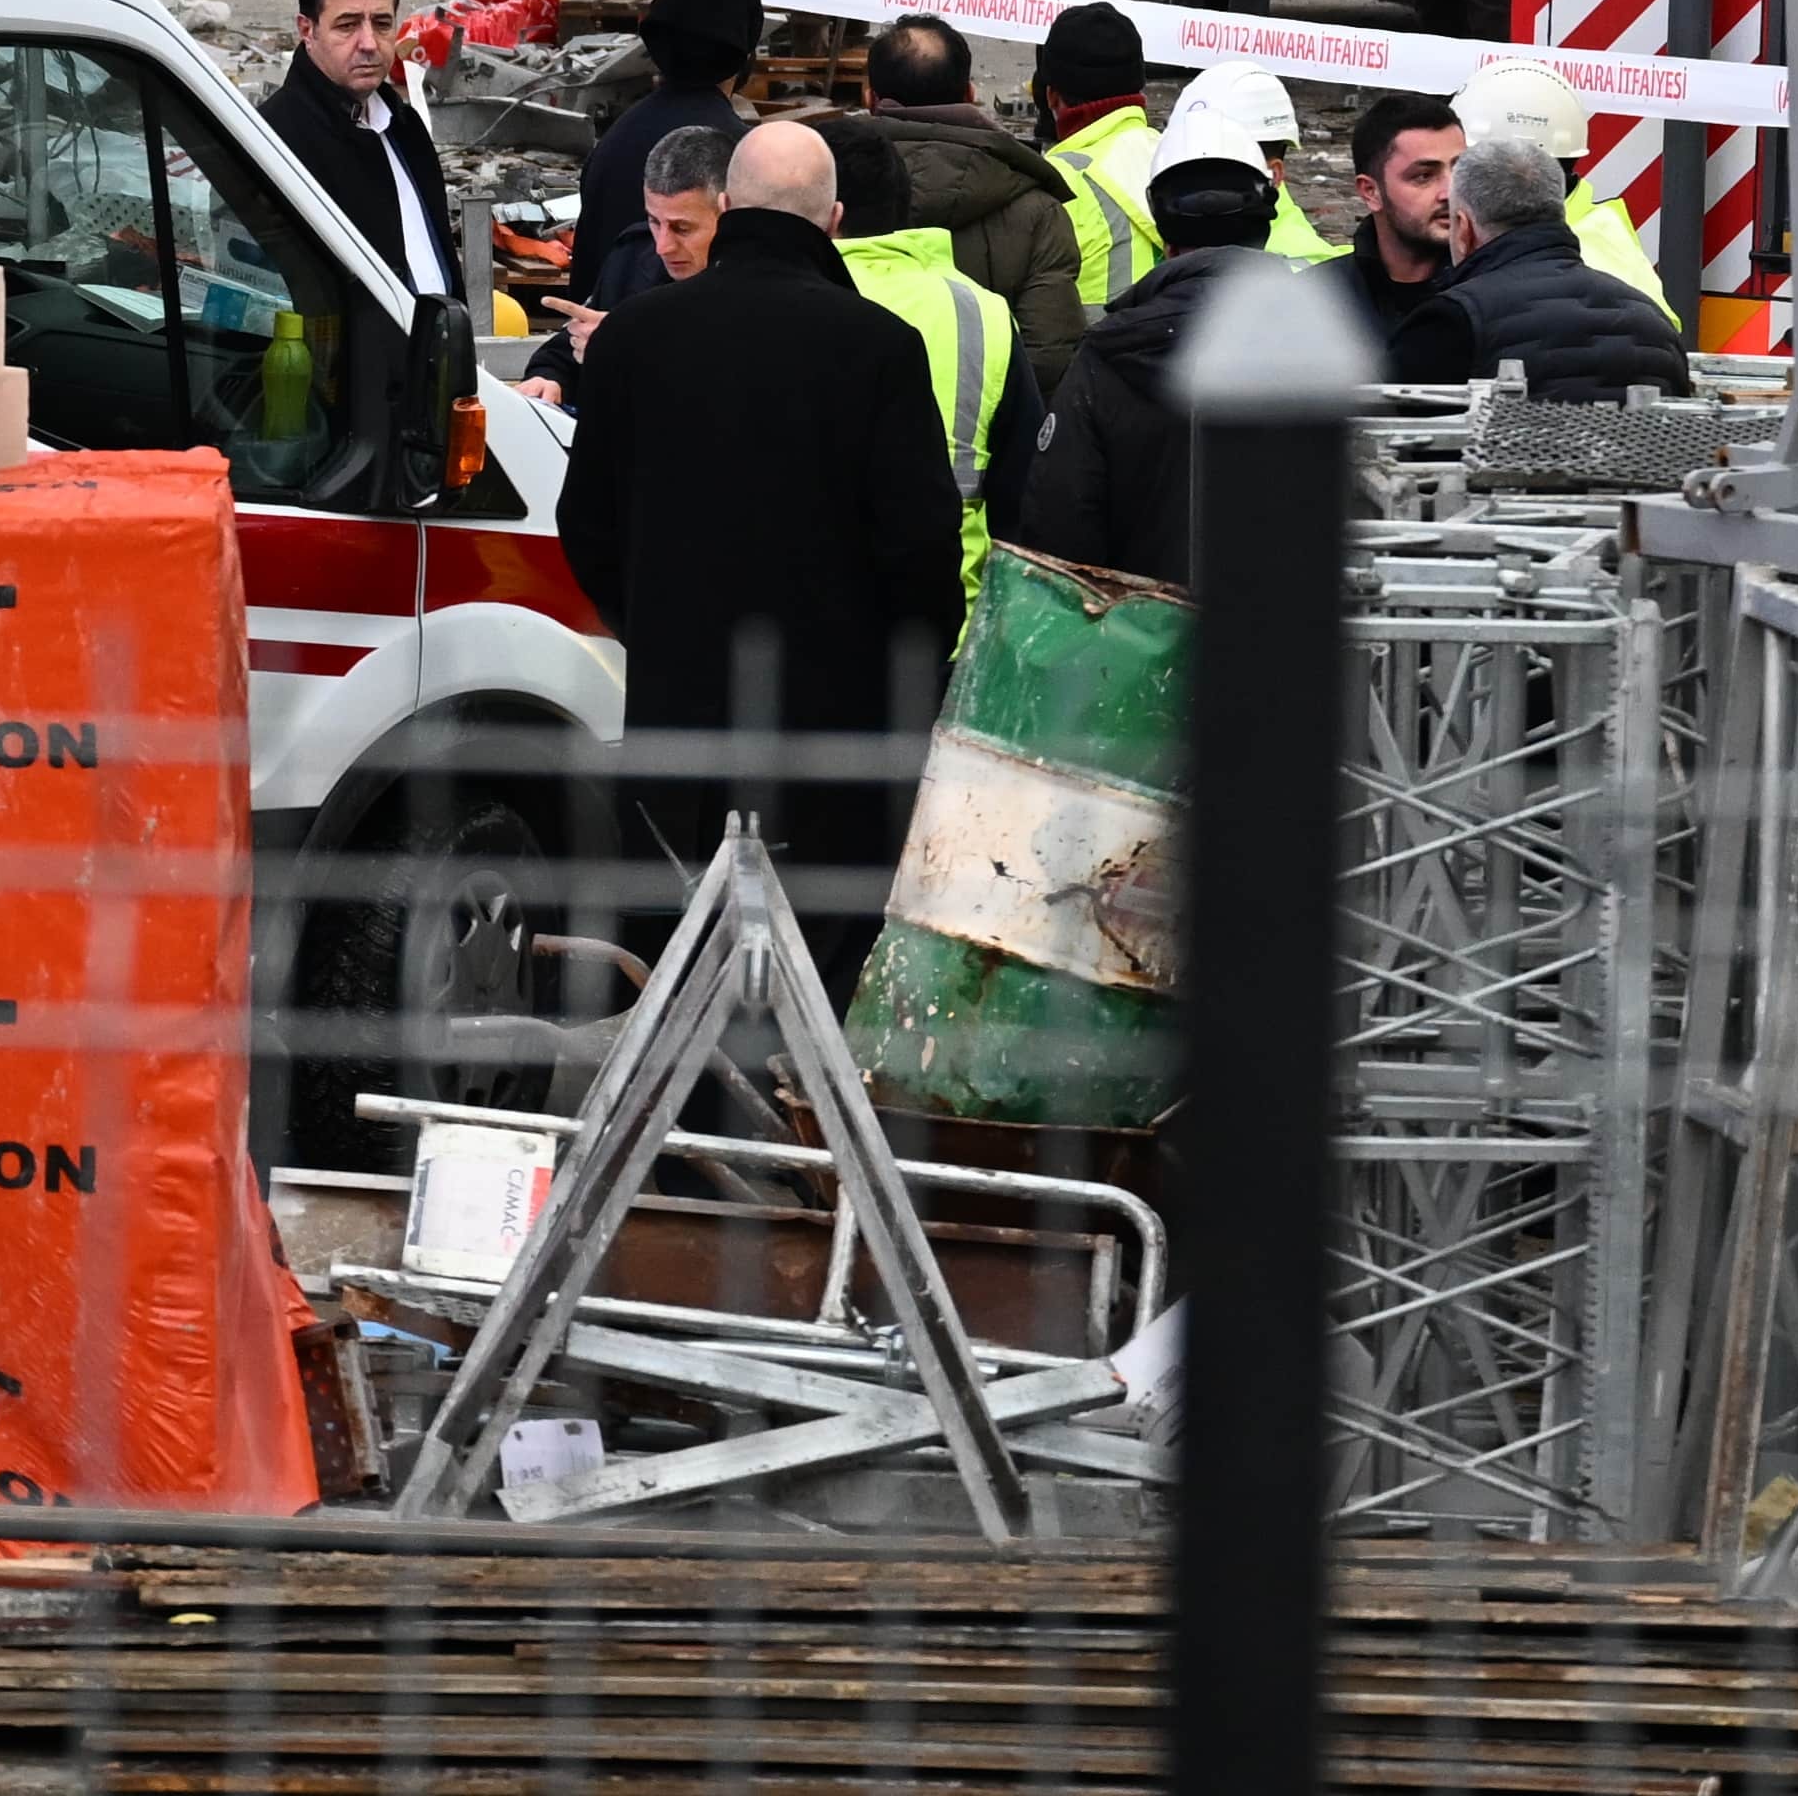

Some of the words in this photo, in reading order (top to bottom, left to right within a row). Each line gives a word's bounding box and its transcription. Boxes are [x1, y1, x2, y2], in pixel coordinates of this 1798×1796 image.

[1253, 29, 1316, 61] ANKARA
[1319, 34, 1390, 71] İTFAİYESİ
[1617, 61, 1688, 100] İTFAİYESİ
